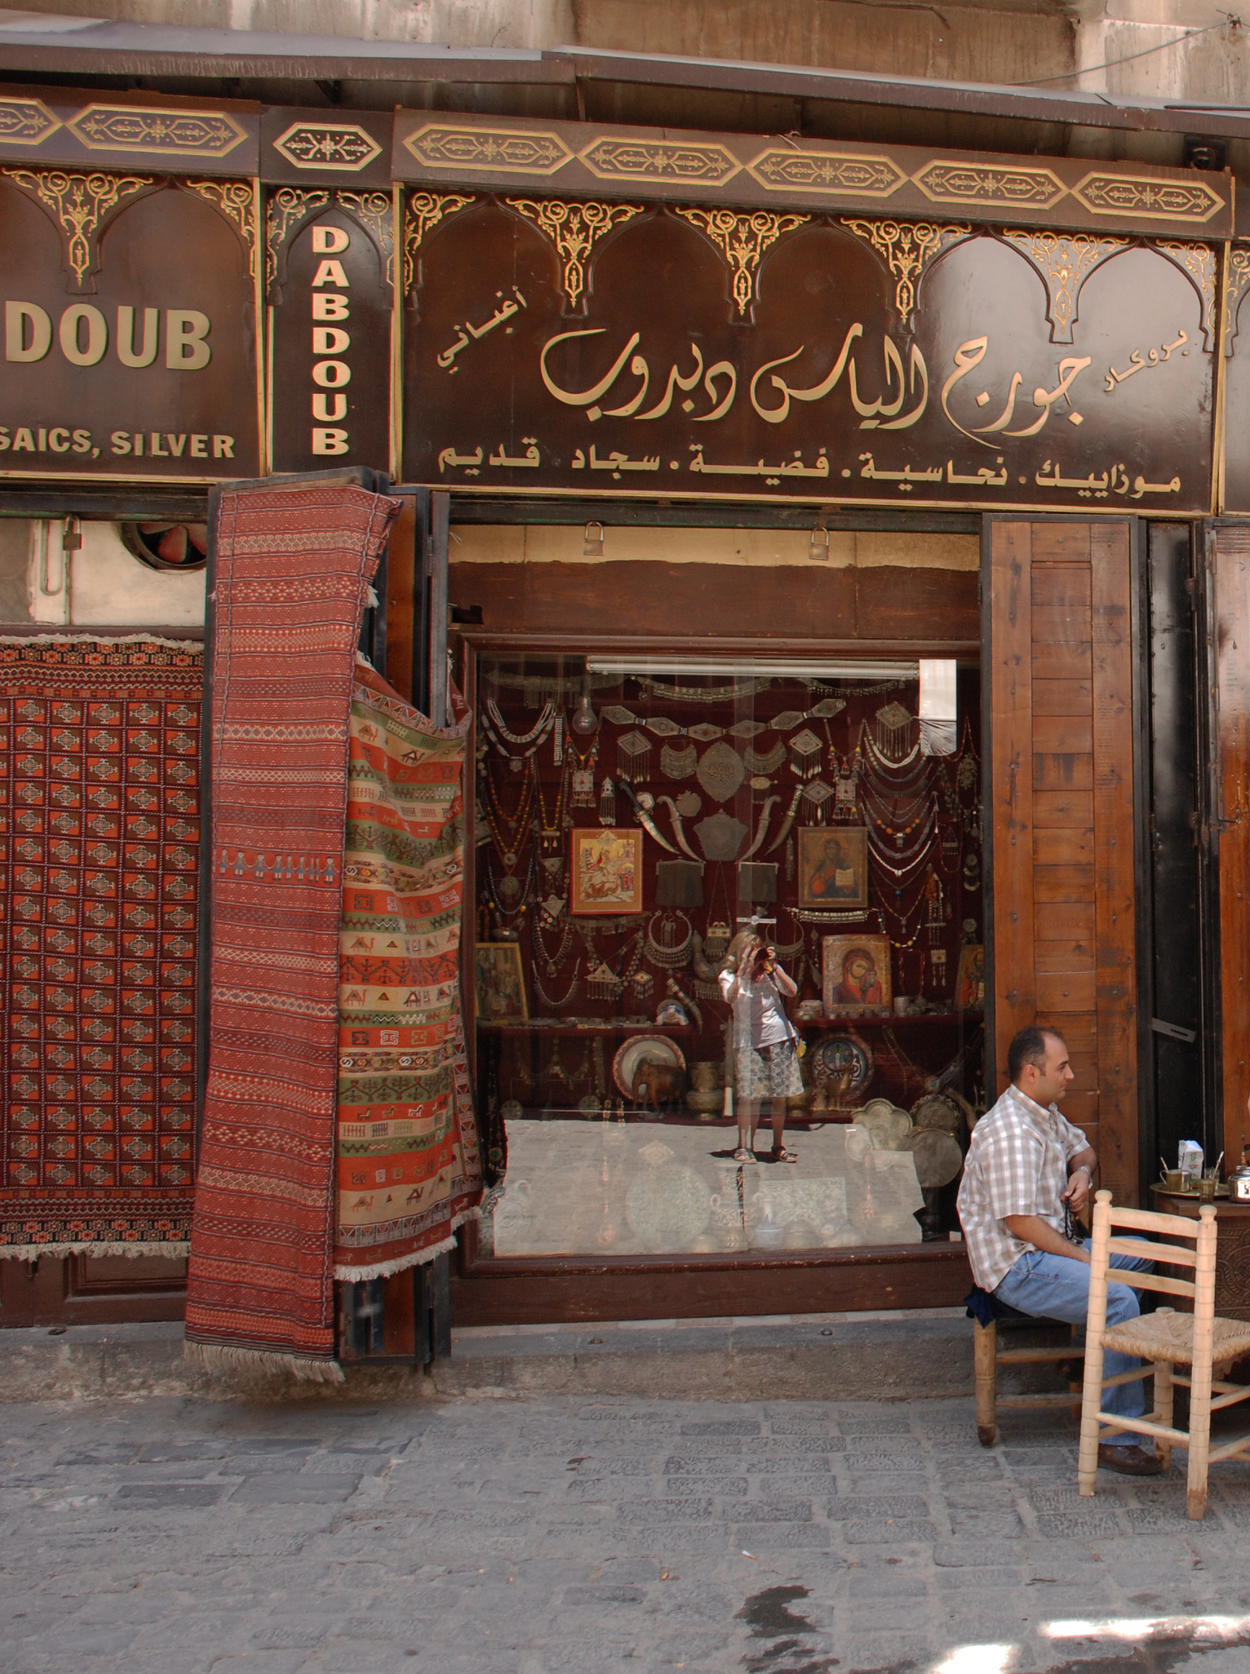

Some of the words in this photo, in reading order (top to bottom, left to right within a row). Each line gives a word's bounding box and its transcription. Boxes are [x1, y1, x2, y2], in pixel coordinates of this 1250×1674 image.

[5, 300, 212, 370] DOUB
[311, 225, 351, 456] DABDOUB
[540, 327, 737, 421] دبدوب
[1103, 329, 1188, 392] بروكار
[941, 335, 1091, 449] جورج
[111, 431, 236, 458] SILVER
[439, 436, 541, 476] قديم
[572, 444, 660, 479] سجاد
[689, 444, 830, 486] فضية
[860, 452, 1008, 491] نحاسية
[1035, 459, 1181, 498] موزاييك
